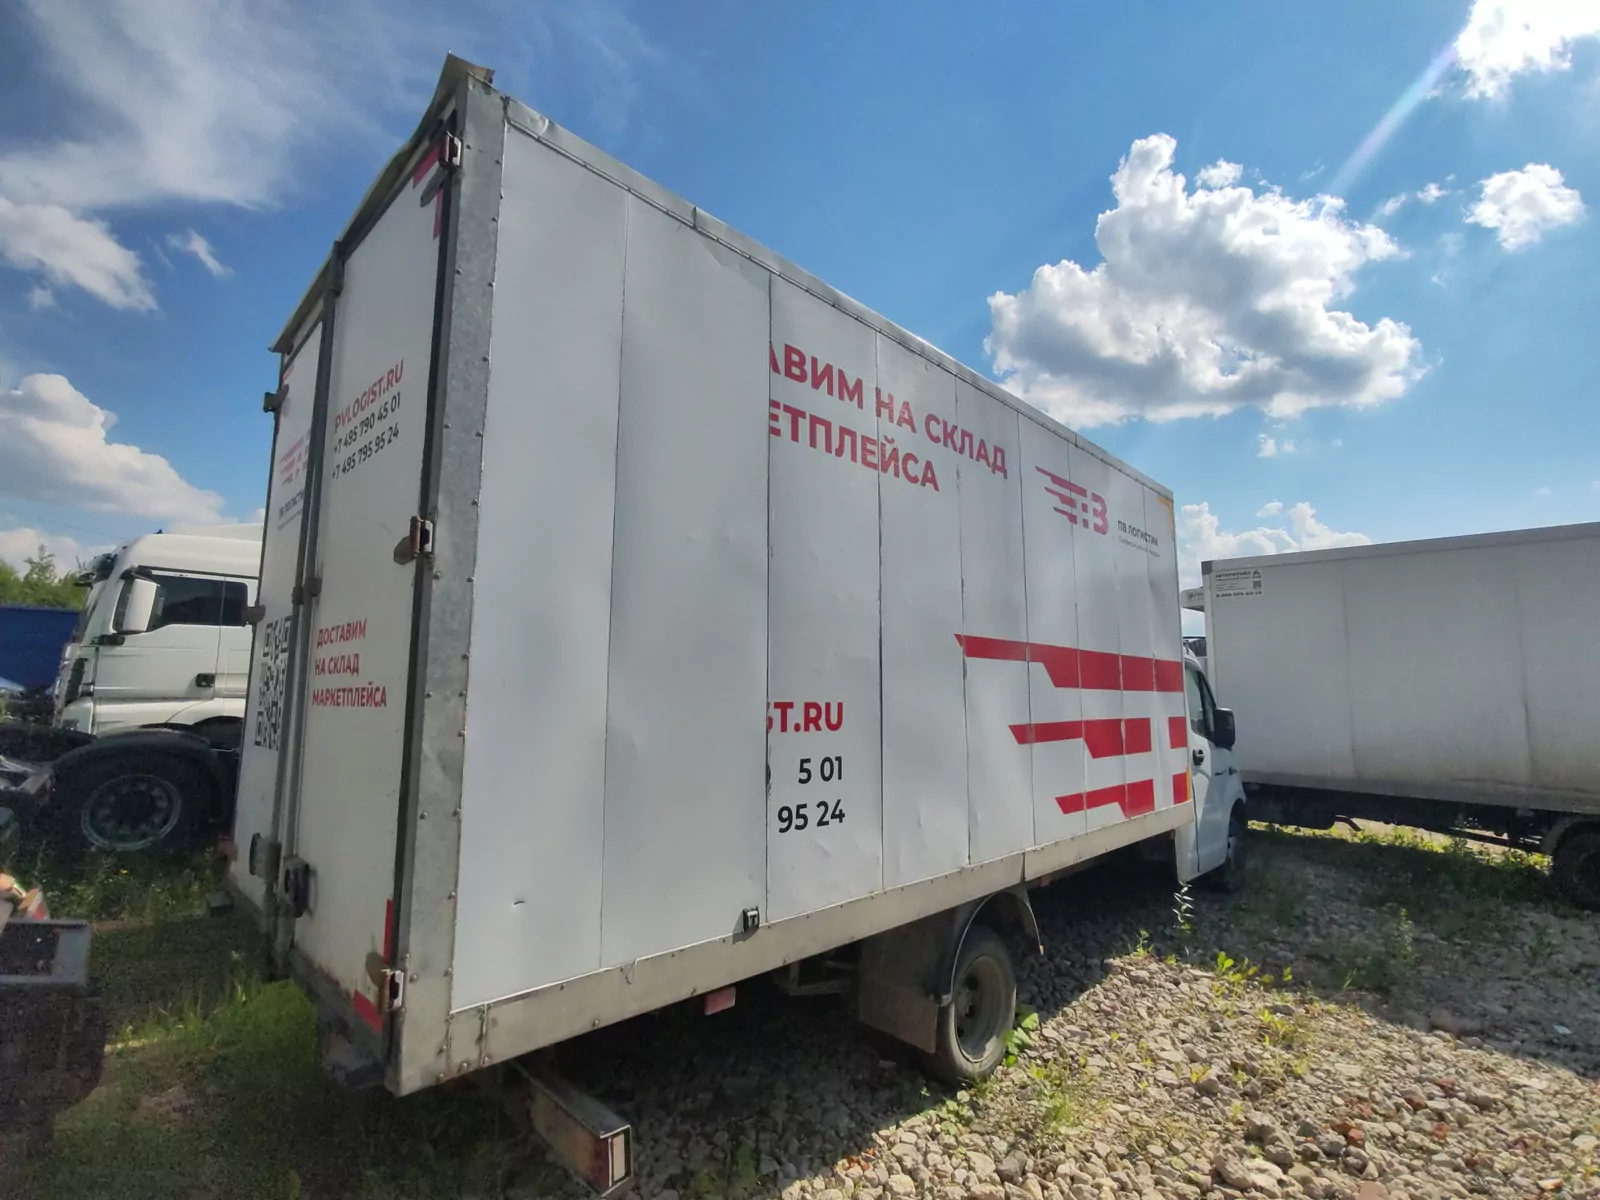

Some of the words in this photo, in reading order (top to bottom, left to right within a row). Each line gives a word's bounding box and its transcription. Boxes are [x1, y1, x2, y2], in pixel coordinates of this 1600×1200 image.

[335, 358, 404, 434] PVLOGIST.RU
[334, 437, 342, 454] +7
[343, 425, 358, 448] 495
[359, 412, 375, 438] 790
[377, 401, 389, 422] 45
[390, 391, 401, 413] 01
[875, 386, 918, 433] НА
[924, 413, 1008, 479] СКЛАД
[332, 464, 340, 480] +7
[341, 452, 356, 475] 495
[357, 441, 373, 464] 795
[374, 431, 386, 454] 95
[386, 421, 399, 445] 24
[317, 619, 367, 649] ДОСТАВИМ
[315, 658, 325, 676] НА
[328, 653, 360, 677] СКЛАД
[312, 681, 387, 707] МАРКЕТПЛЕЙСА
[820, 755, 843, 782] 01
[777, 803, 809, 834] 95
[816, 798, 846, 827] 24
